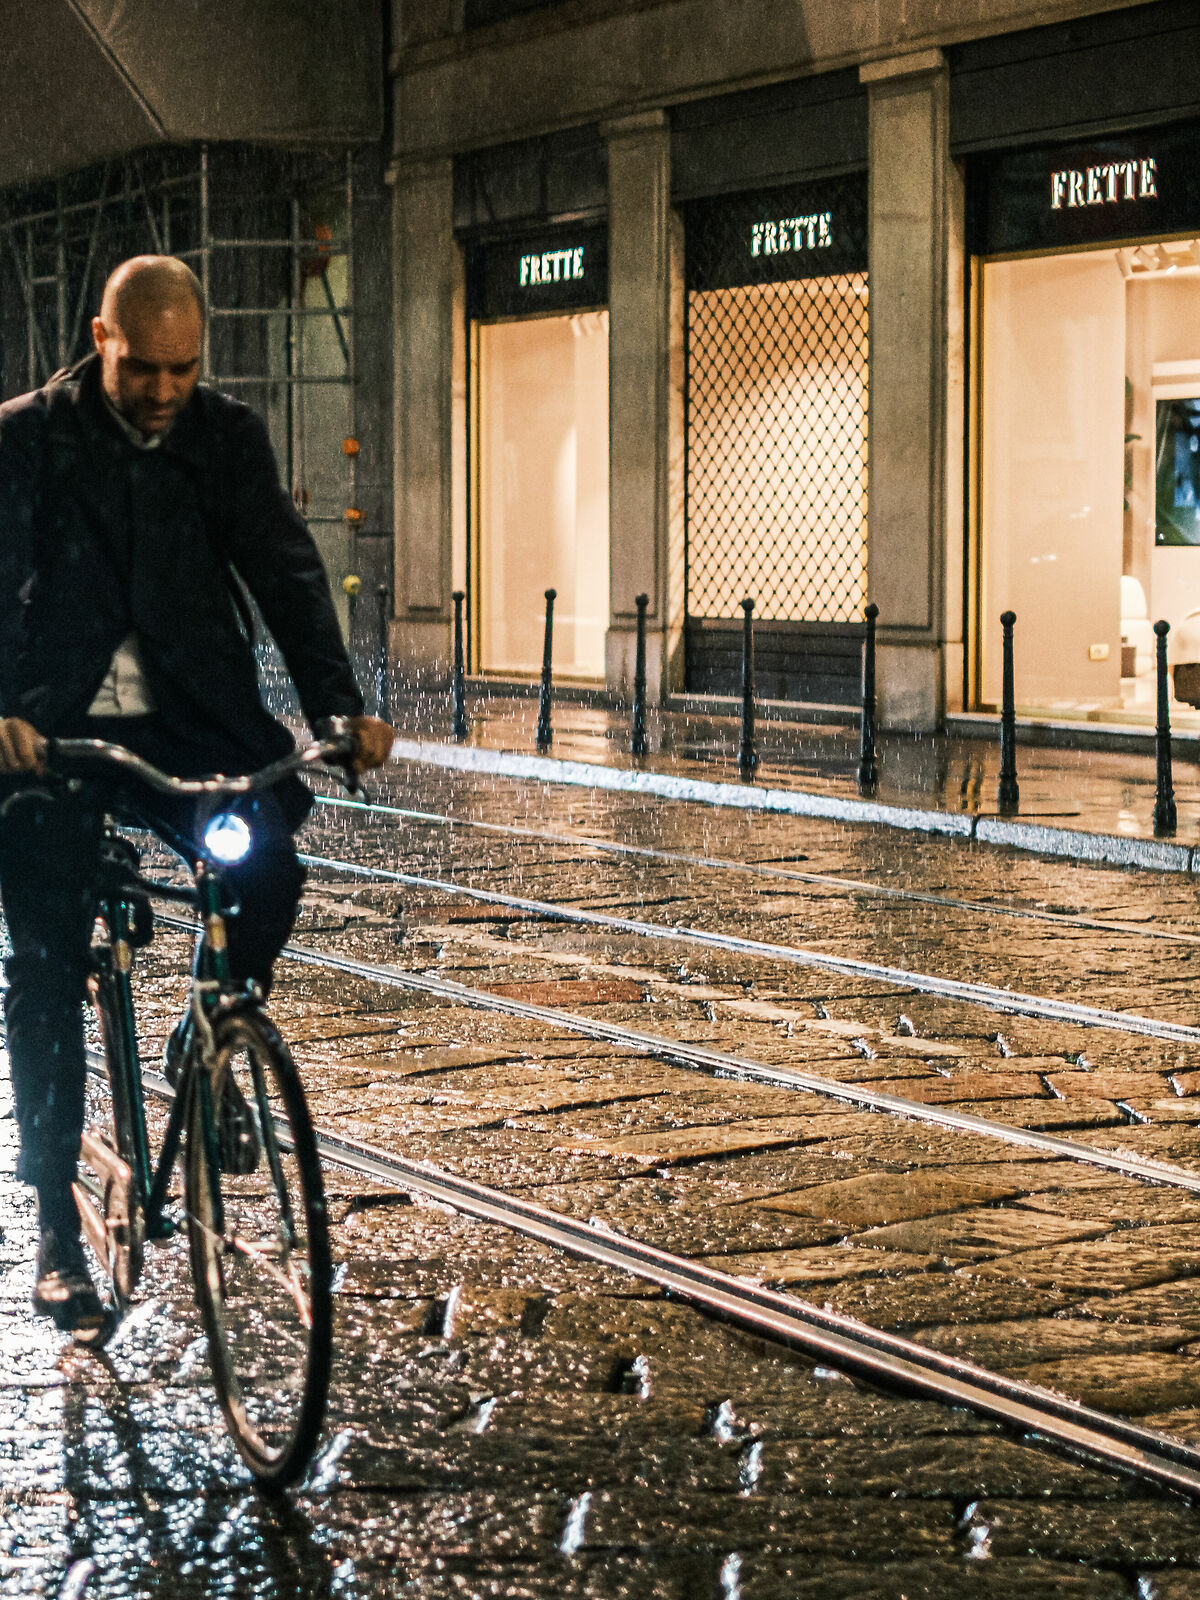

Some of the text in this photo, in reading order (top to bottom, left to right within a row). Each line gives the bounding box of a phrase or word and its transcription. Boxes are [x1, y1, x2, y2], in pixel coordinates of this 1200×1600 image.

[1050, 158, 1158, 209] FRETTE
[751, 212, 832, 257] FRETTE
[520, 247, 584, 286] FRETTE
